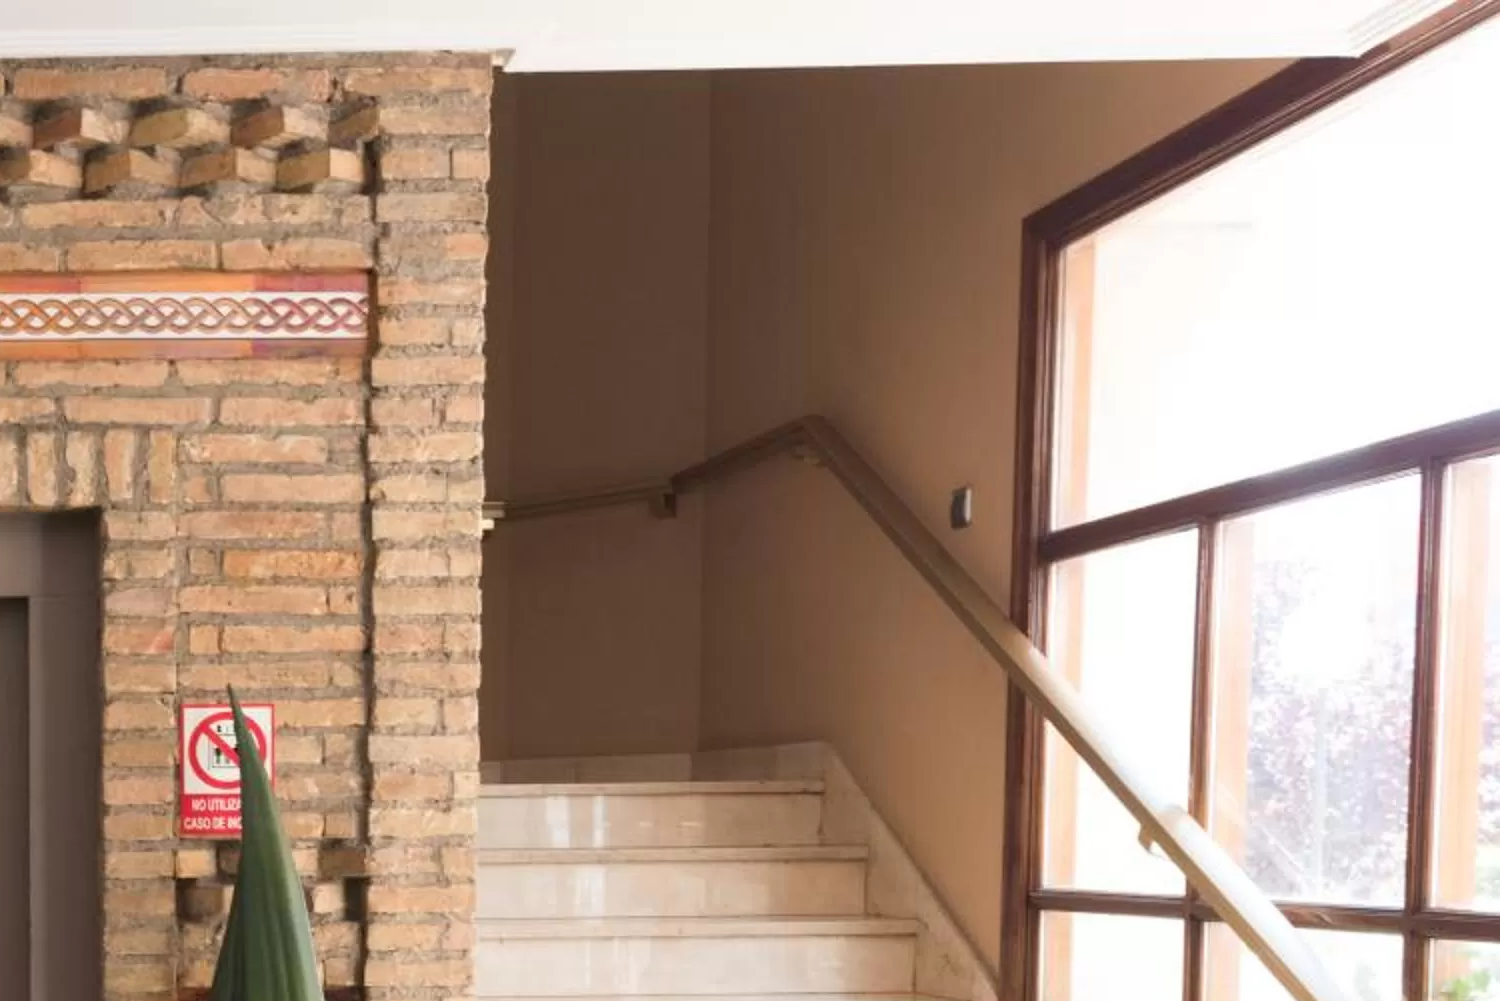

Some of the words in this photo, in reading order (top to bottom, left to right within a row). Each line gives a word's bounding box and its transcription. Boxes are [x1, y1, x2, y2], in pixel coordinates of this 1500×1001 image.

[191, 798, 206, 811] NO
[184, 816, 210, 830] CASO
[212, 816, 226, 829] DE
